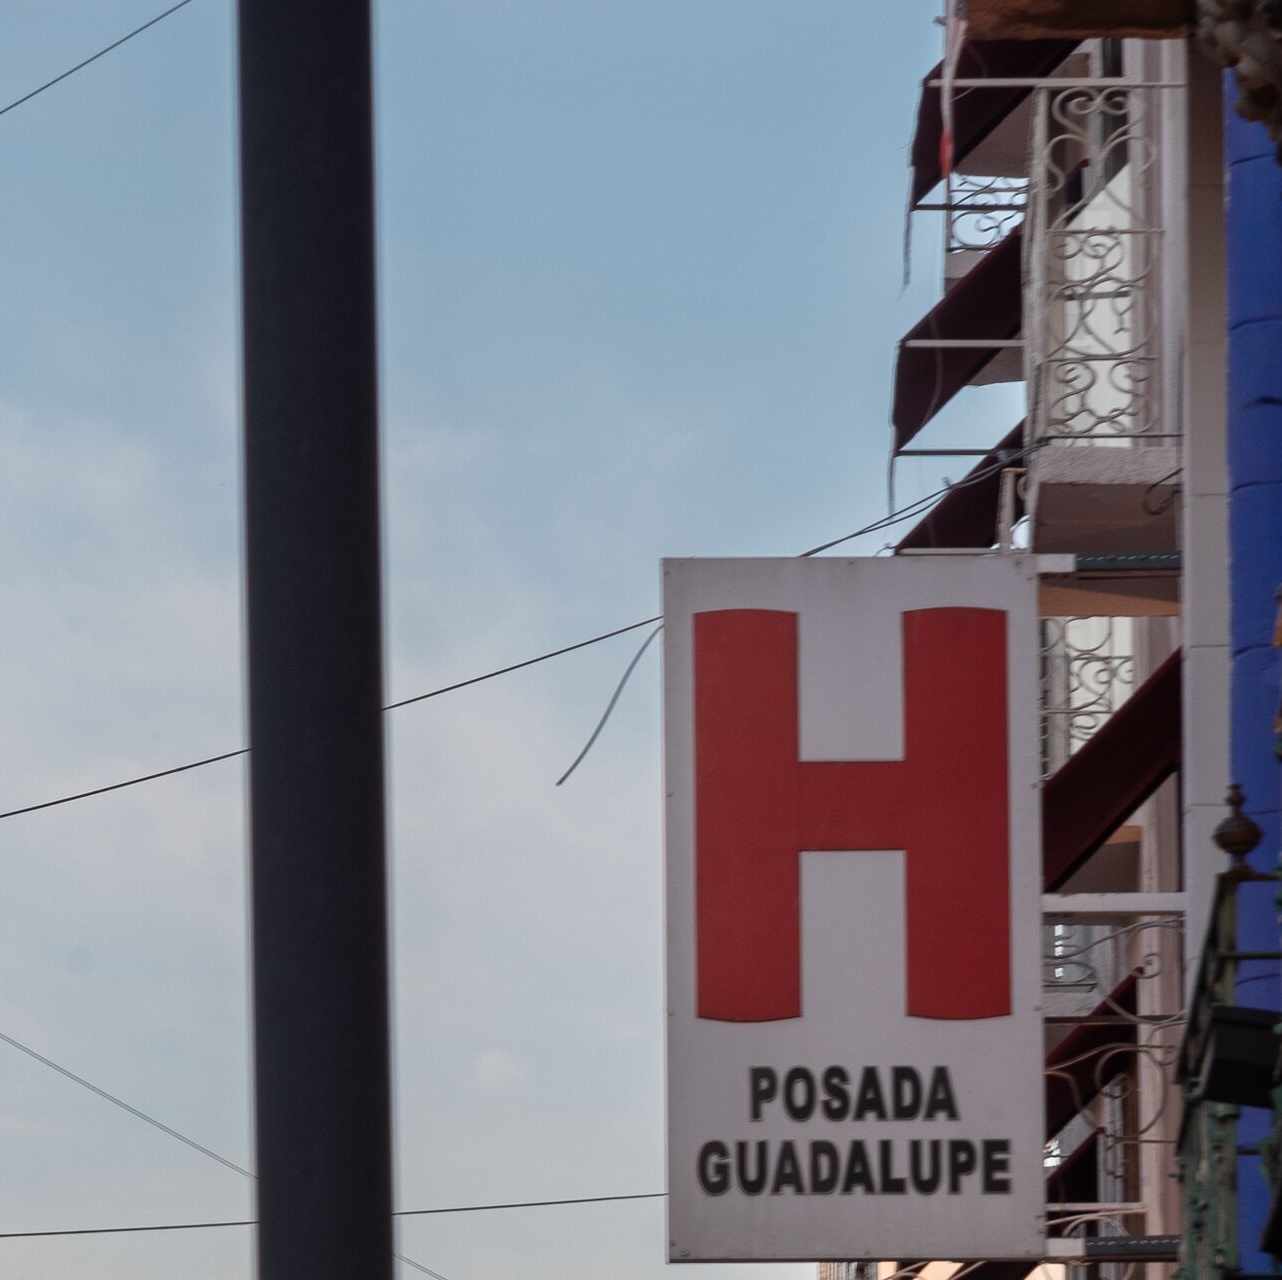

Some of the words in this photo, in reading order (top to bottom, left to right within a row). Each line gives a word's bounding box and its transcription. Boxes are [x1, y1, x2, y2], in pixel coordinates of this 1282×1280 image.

[693, 607, 1012, 1022] H
[749, 1065, 959, 1123] POSADA
[696, 1138, 1012, 1196] GUADALUPE
